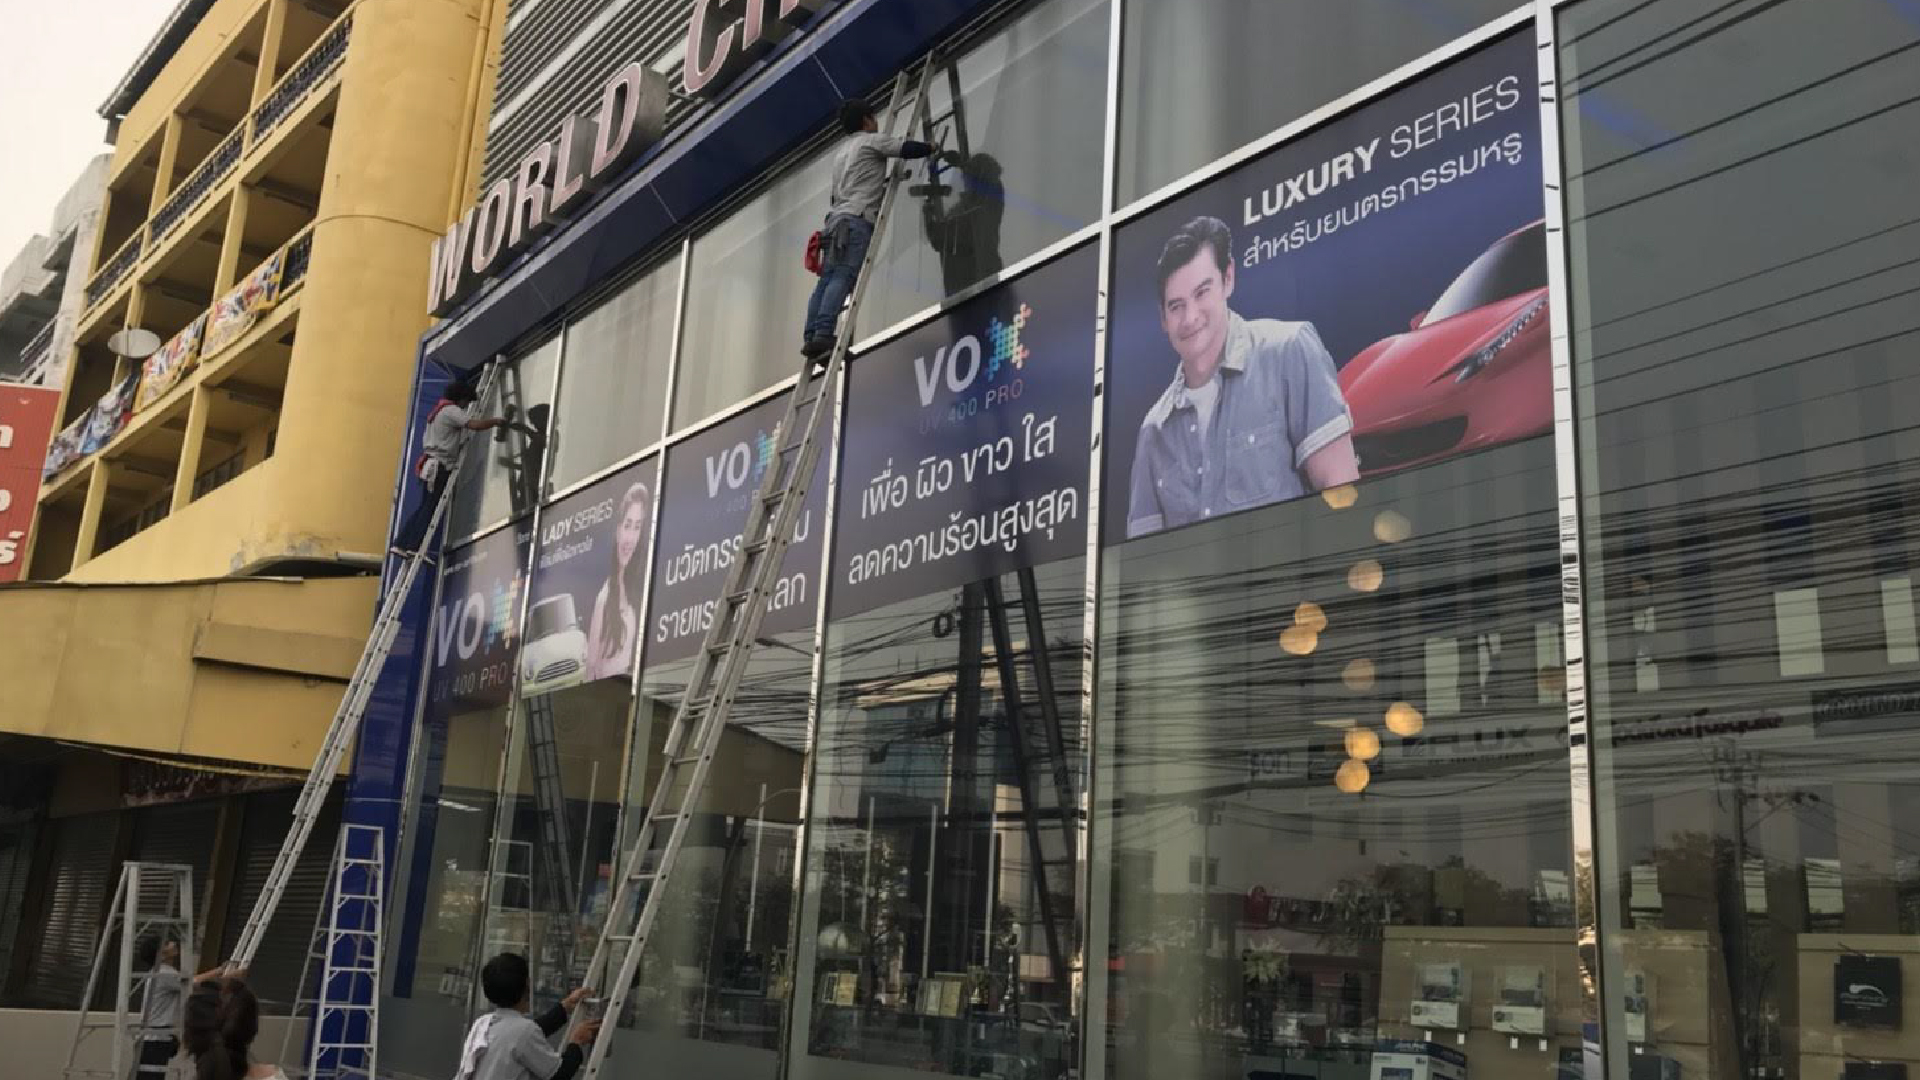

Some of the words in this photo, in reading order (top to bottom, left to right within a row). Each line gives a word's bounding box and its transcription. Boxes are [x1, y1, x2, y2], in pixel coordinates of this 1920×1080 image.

[427, 62, 642, 315] WORLD
[1243, 137, 1381, 226] LUXURY
[1390, 75, 1520, 159] SERIES
[985, 379, 1024, 410] PRO
[861, 457, 908, 519] เพื่อ
[916, 456, 953, 499] ผิว
[961, 436, 1013, 483] ขาว
[1021, 412, 1058, 462] ใส
[541, 515, 572, 545] LADY
[574, 498, 613, 533] SERIES
[848, 486, 1078, 585] ลดความร้อนสูงสุด
[480, 662, 508, 691] PRO
